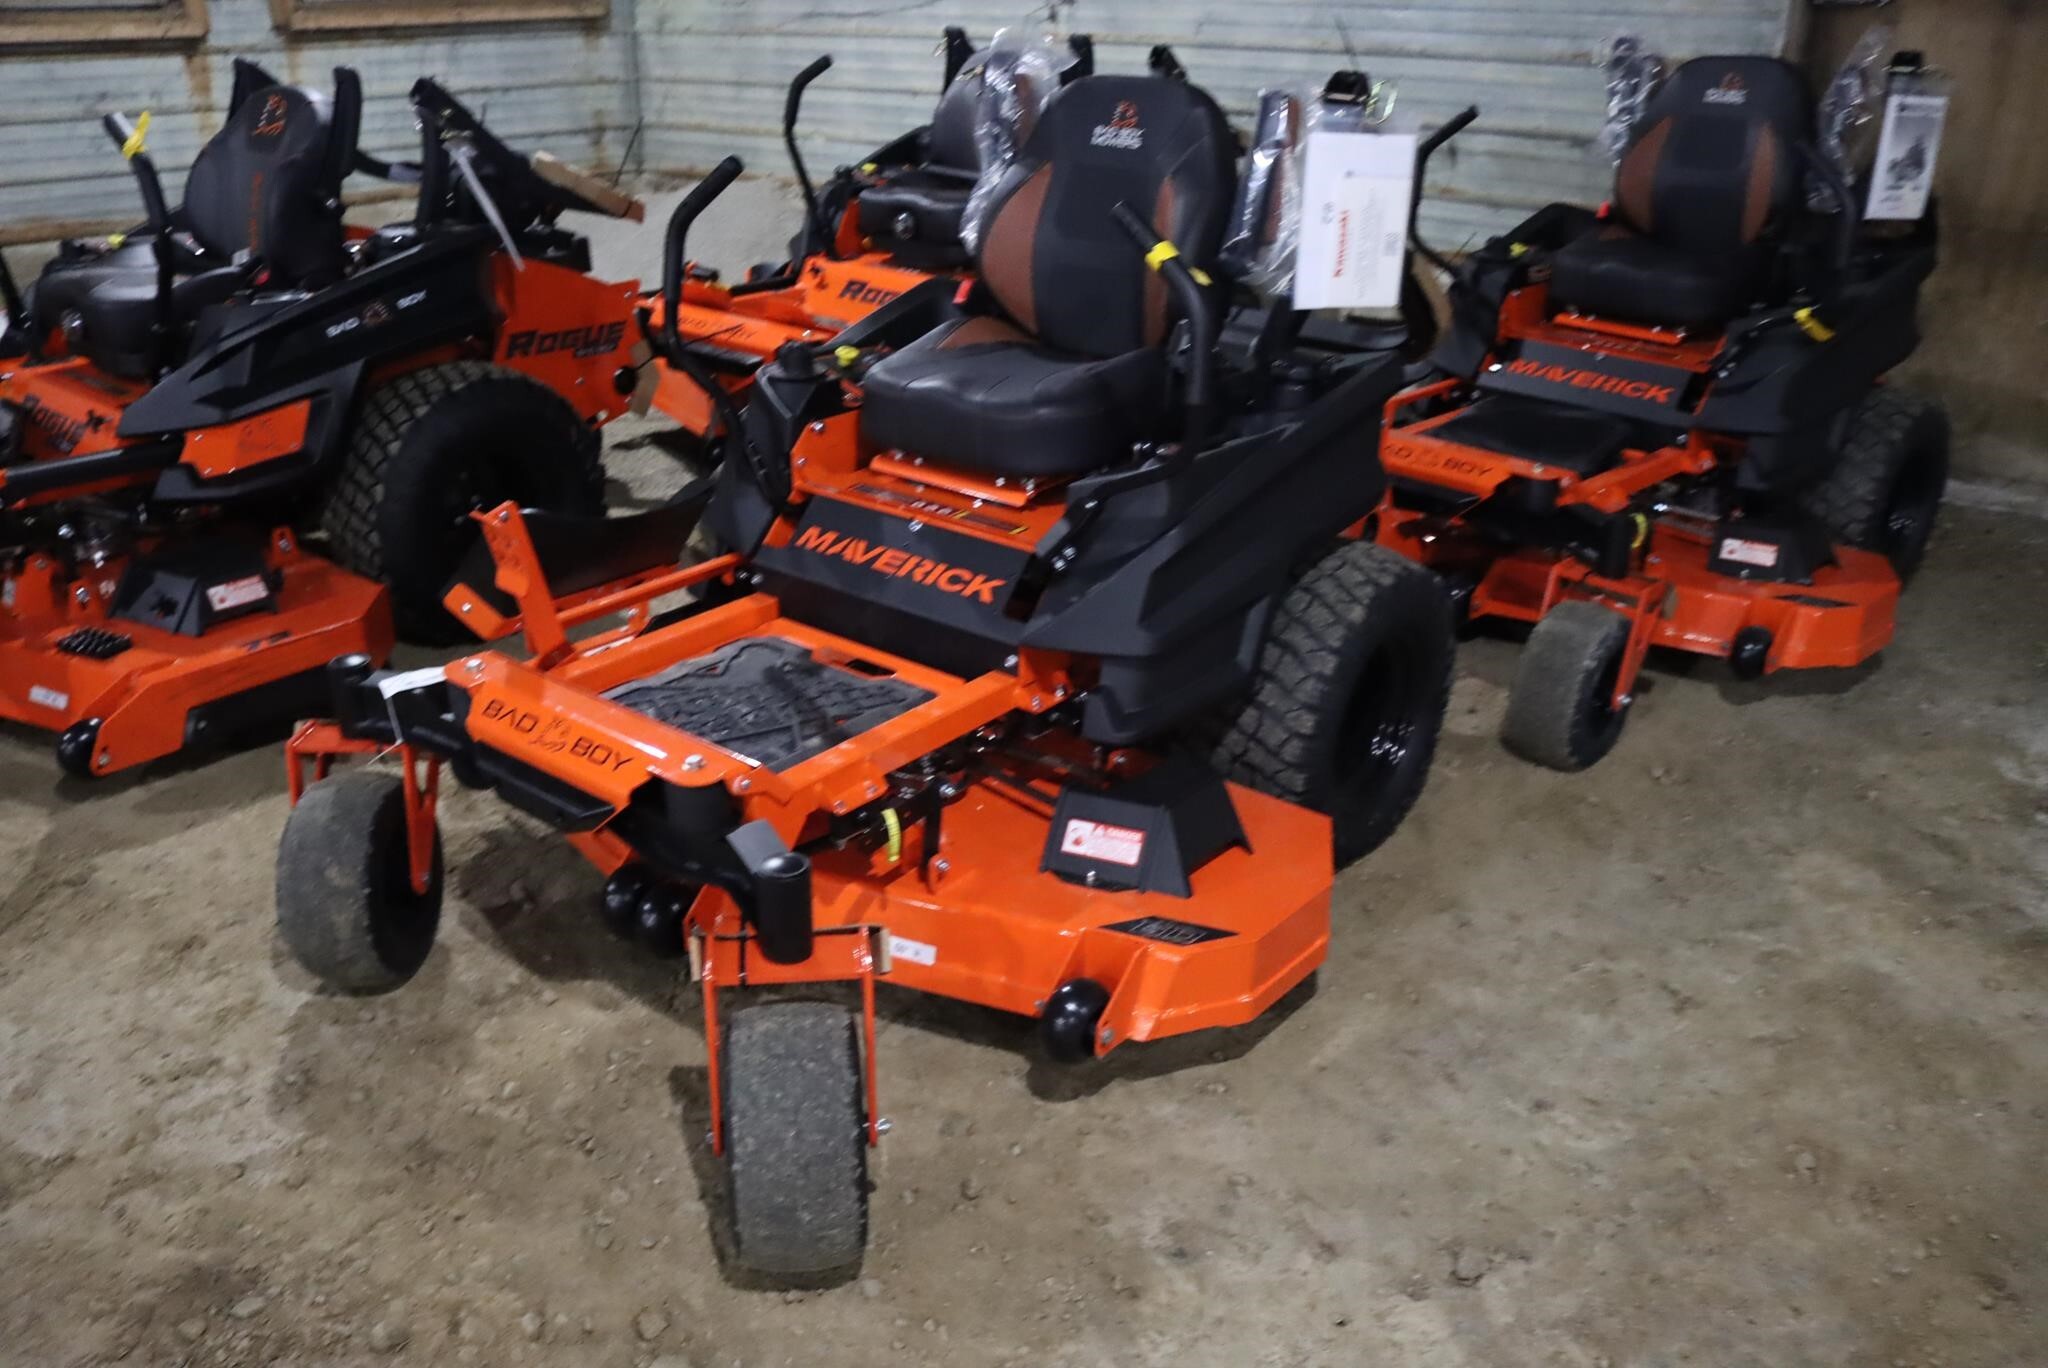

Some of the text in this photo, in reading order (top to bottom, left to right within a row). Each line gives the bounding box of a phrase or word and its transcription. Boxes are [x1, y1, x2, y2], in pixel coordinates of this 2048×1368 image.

[1507, 358, 1676, 403] MAVERICK
[795, 525, 1007, 604] MAVERICK
[482, 698, 634, 771] BAD BOY
